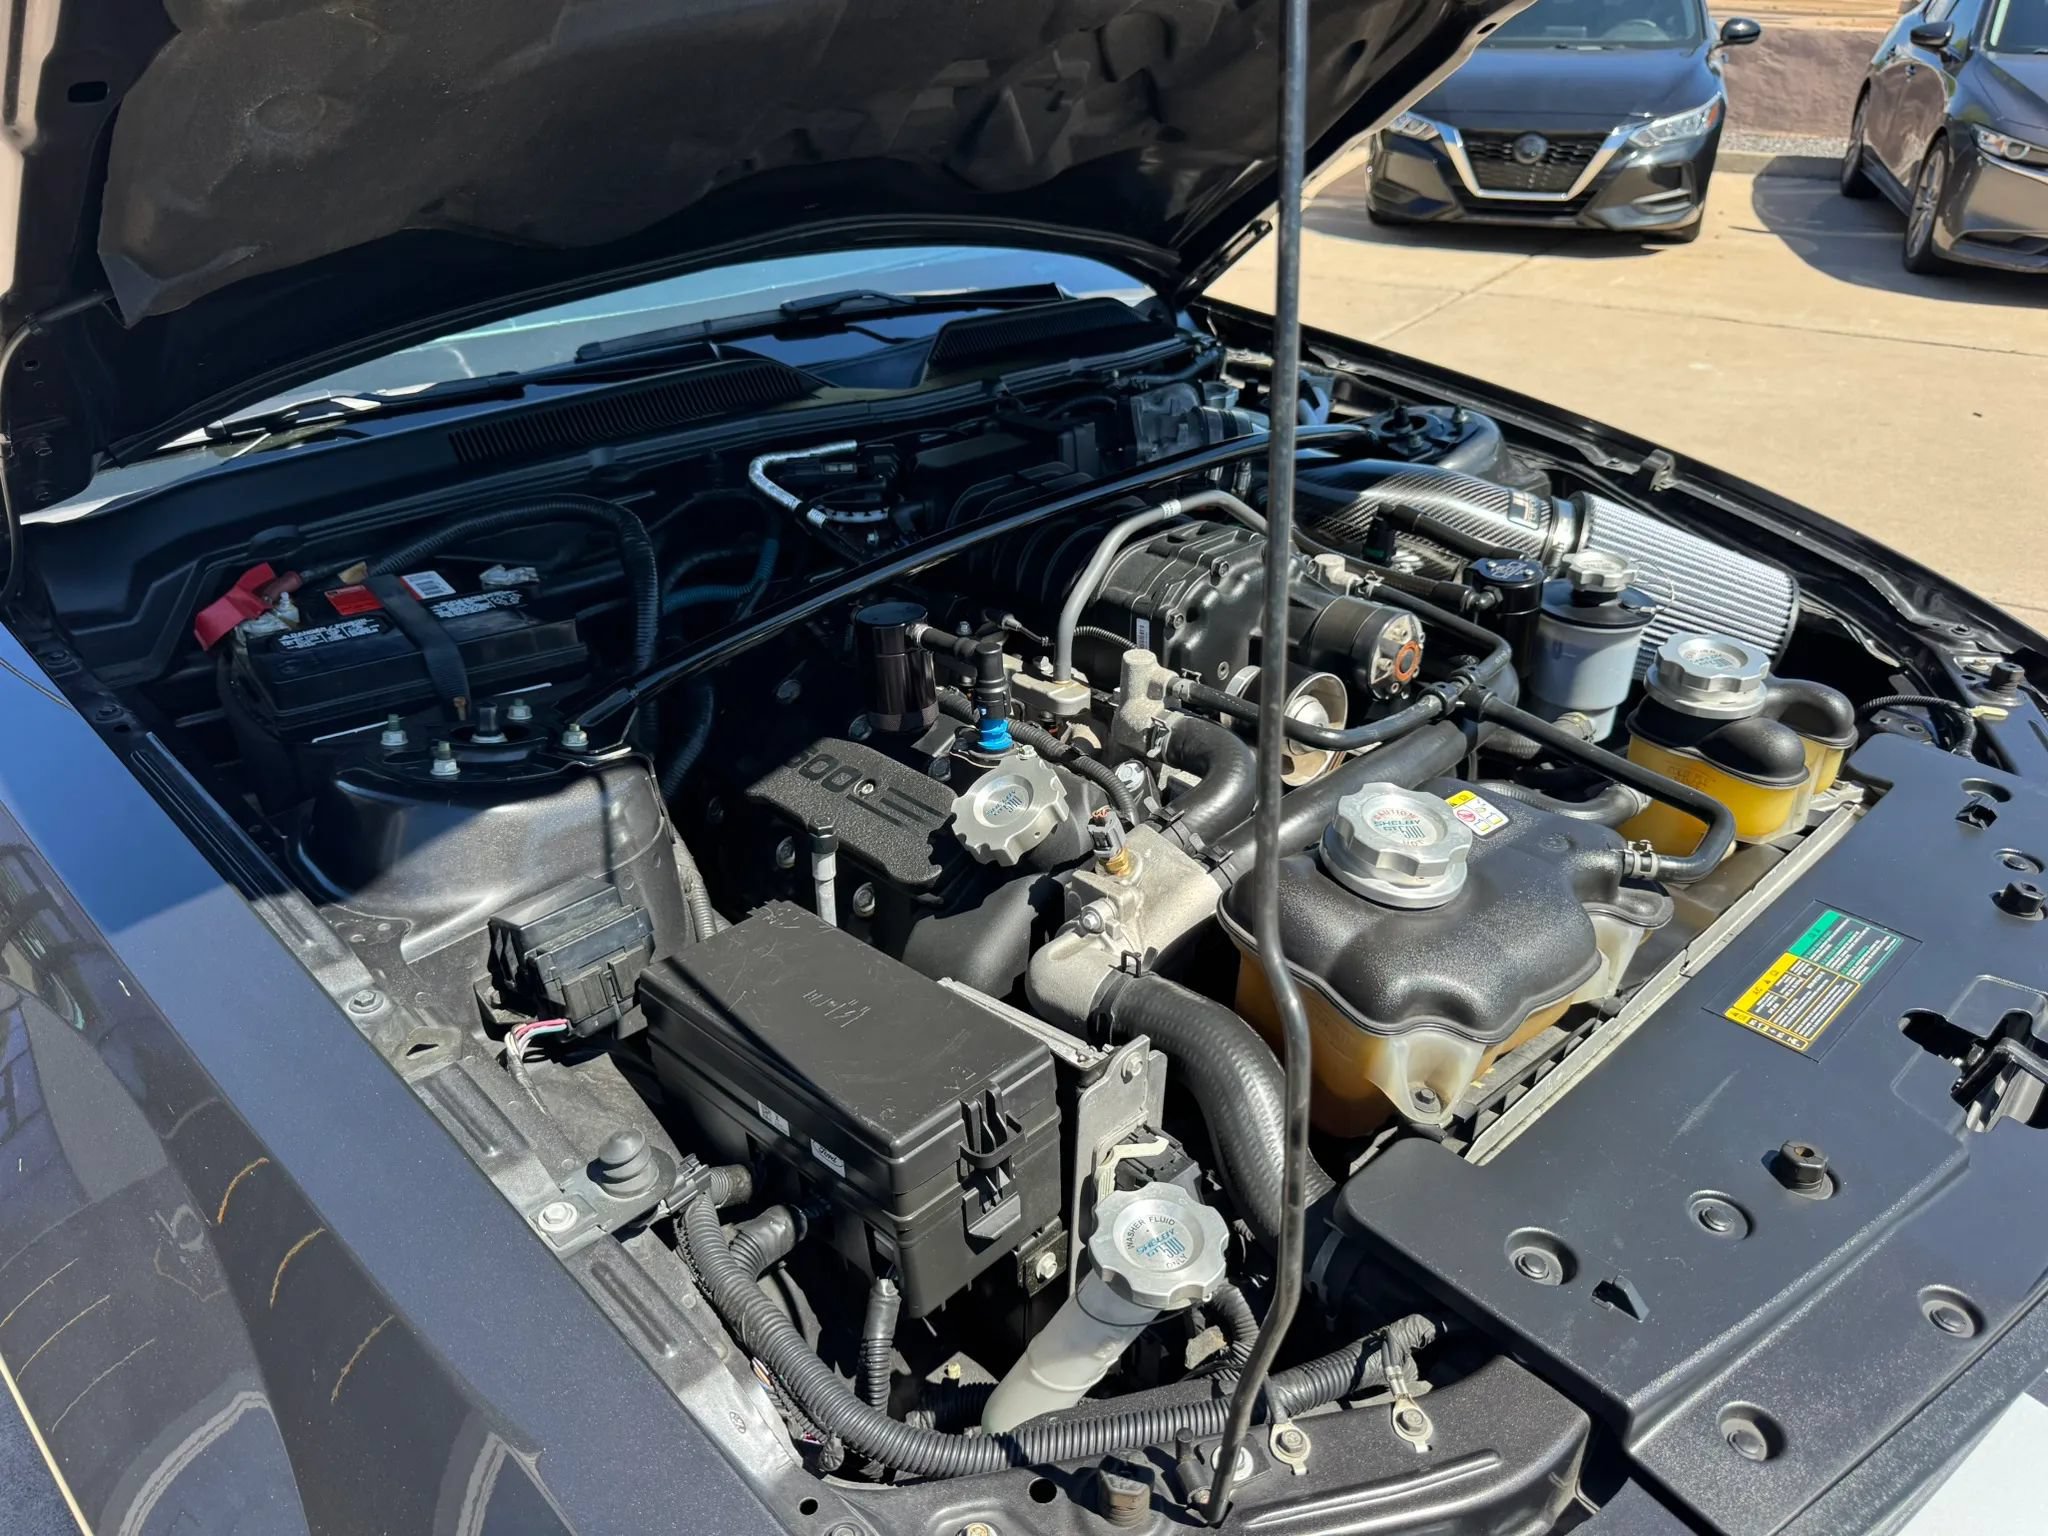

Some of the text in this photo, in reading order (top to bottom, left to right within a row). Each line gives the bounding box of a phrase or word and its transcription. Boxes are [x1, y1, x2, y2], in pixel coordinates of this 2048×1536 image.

[1373, 819, 1421, 827] SHELBY
[1124, 1216, 1176, 1249] WASHER FLUID
[1136, 1228, 1175, 1256] SHELBY
[1165, 1253, 1188, 1269] ONLY
